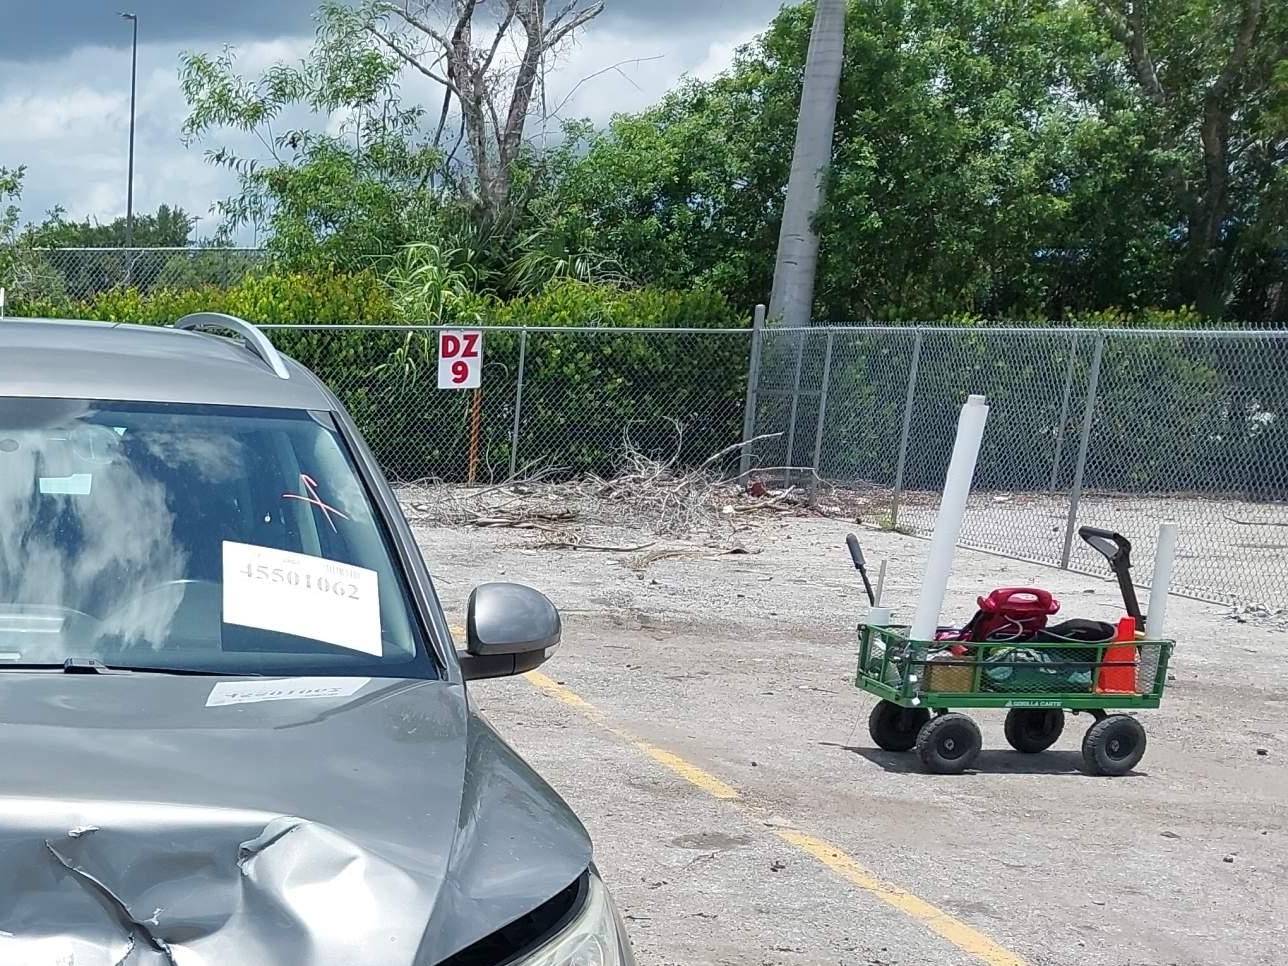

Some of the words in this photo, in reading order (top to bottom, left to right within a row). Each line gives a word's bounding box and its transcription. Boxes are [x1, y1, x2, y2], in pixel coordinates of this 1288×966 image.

[441, 334, 479, 358] DZ
[451, 360, 469, 384] 9
[239, 562, 360, 601] 45501062
